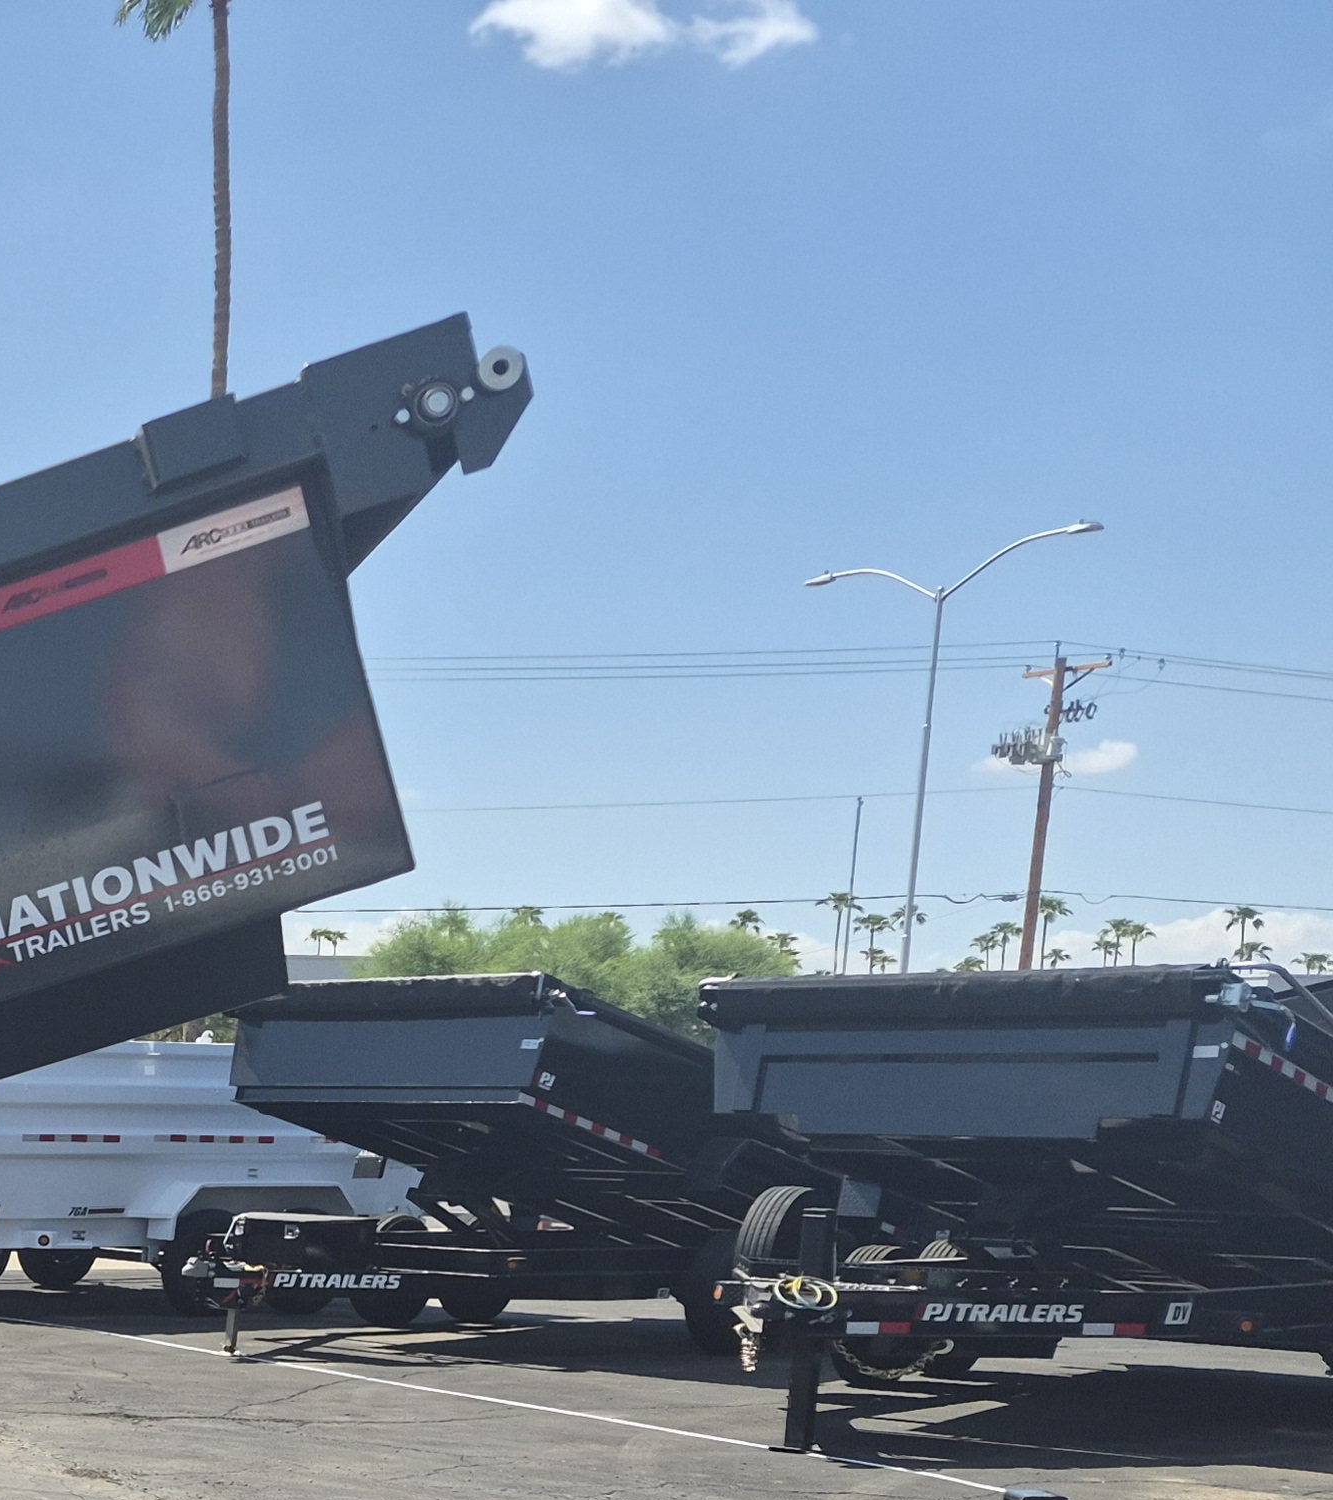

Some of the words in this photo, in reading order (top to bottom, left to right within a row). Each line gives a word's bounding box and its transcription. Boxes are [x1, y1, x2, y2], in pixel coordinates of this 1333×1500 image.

[180, 528, 222, 555] ARC
[6, 901, 151, 963] TRAILERS
[163, 844, 339, 913] 1-866-931-3001
[539, 1071, 556, 1087] PJ
[273, 1273, 298, 1288] PJ
[299, 1274, 402, 1289] TRAILERS
[922, 1303, 954, 1321] PJ
[955, 1303, 1084, 1323] TRAILERS
